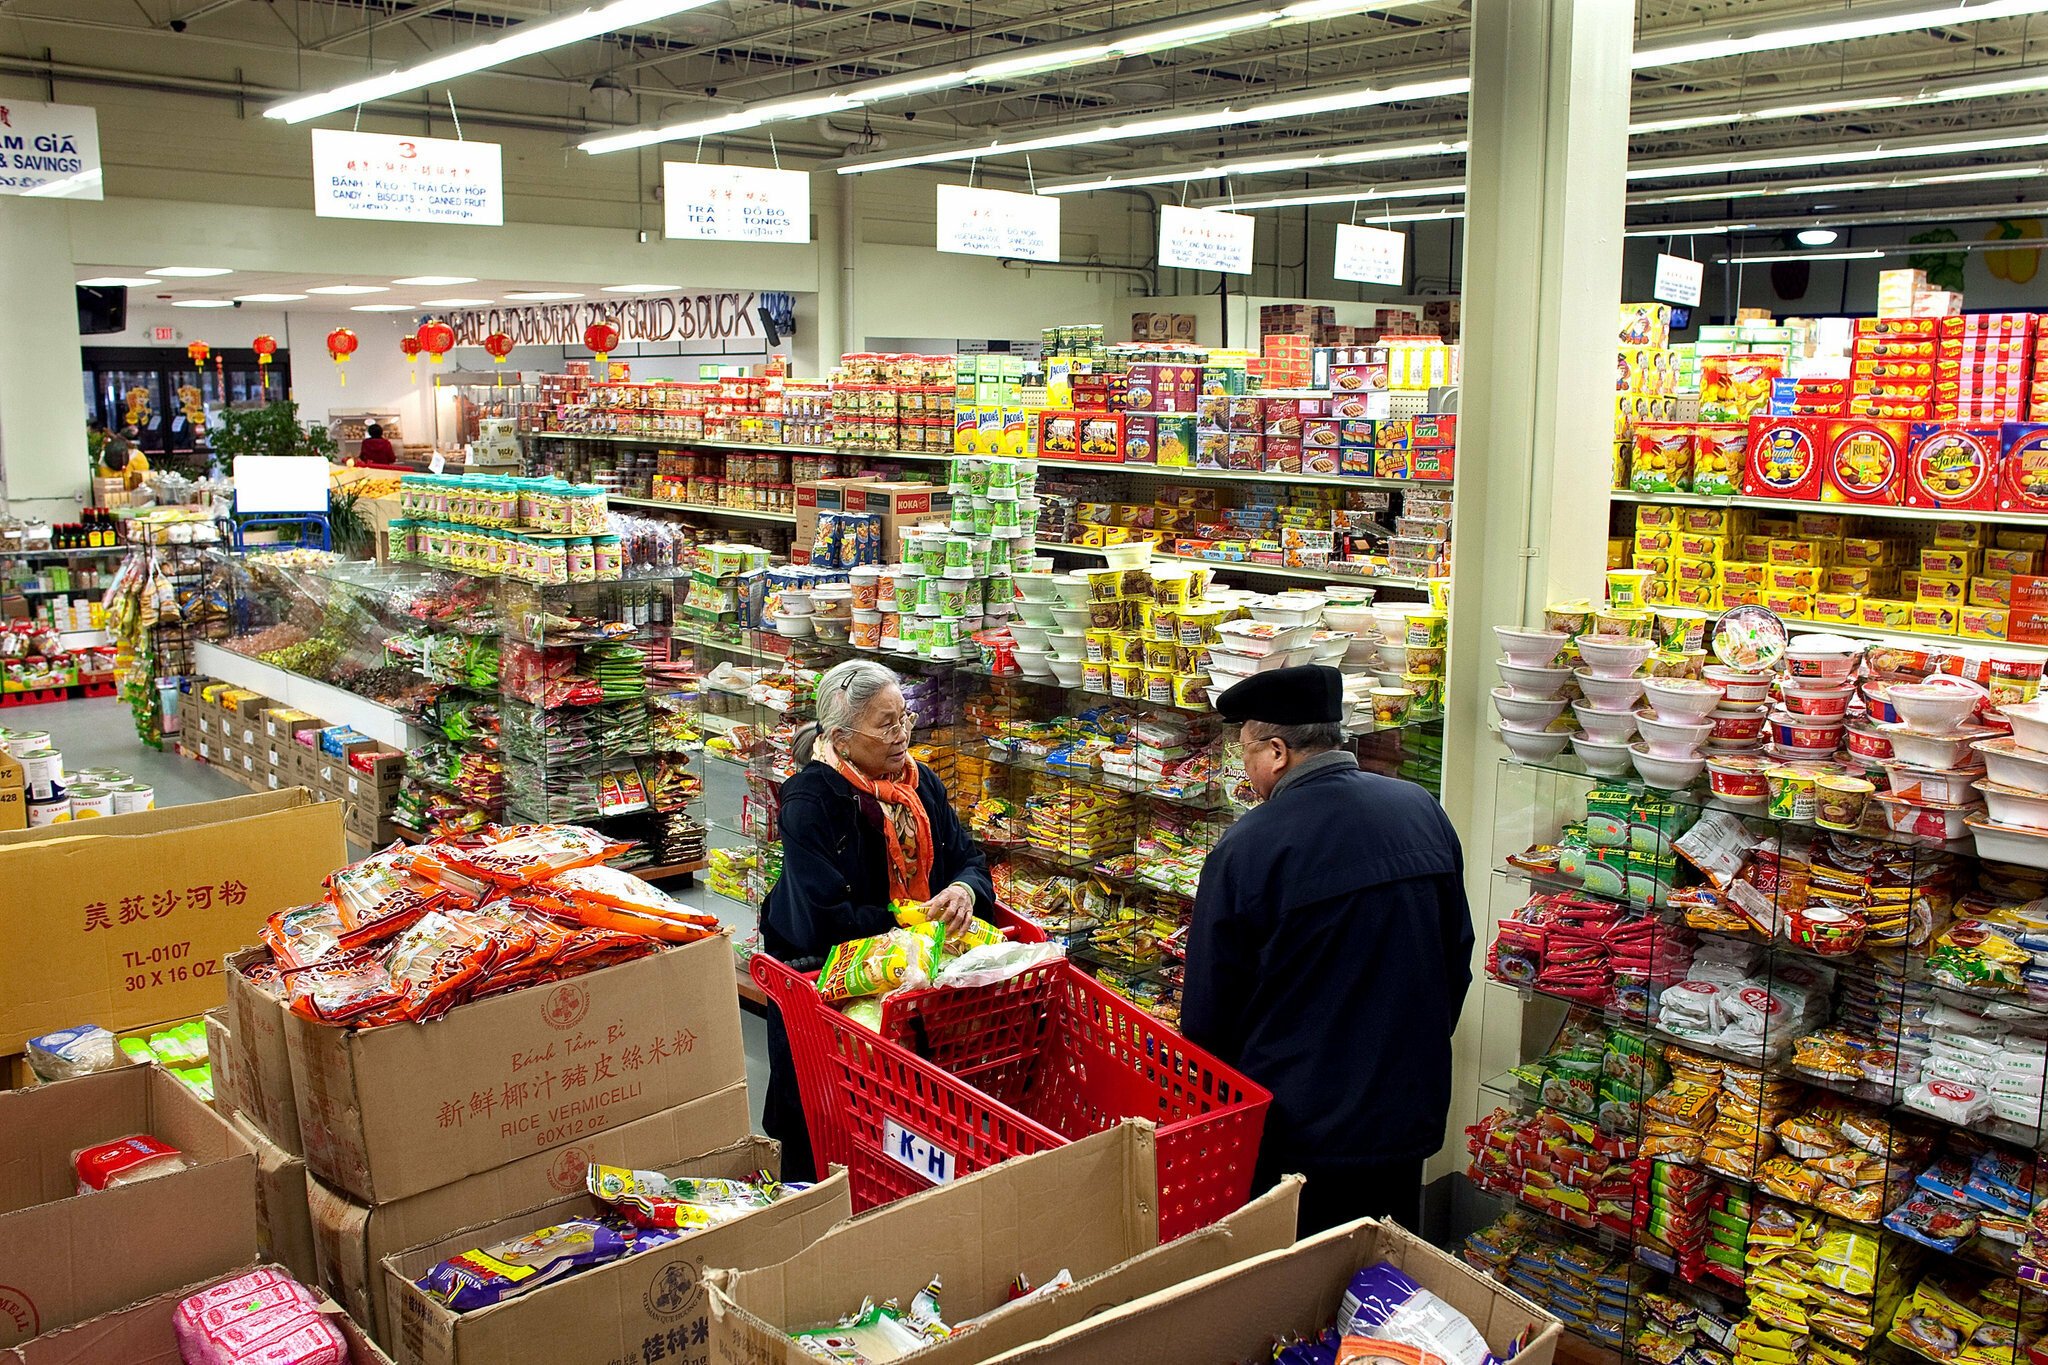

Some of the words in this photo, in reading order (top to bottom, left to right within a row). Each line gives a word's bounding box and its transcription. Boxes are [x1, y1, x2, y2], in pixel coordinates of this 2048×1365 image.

[399, 142, 417, 159] 3
[333, 189, 362, 199] CANDY
[377, 193, 415, 203] BISCUITS
[429, 196, 461, 205] CANNED
[464, 197, 487, 207] FRUIT
[744, 217, 791, 226] TONICS
[1416, 427, 1438, 437] OTAP
[1852, 443, 1878, 456] RUBY
[1416, 461, 1439, 470] OTAP
[898, 500, 918, 510] KOKA
[122, 942, 191, 968] TL-0107
[125, 974, 146, 992] 30
[151, 970, 163, 987] X
[168, 966, 187, 983] 16
[192, 959, 217, 978] OZ
[512, 1042, 556, 1073] Bánh
[436, 1027, 699, 1130] 新鮮椰汁豬皮絲米粉
[500, 1113, 541, 1139] RICE
[549, 1081, 643, 1123] VERMICELLI
[536, 1120, 583, 1147] 60X12
[661, 1315, 675, 1325] QUE
